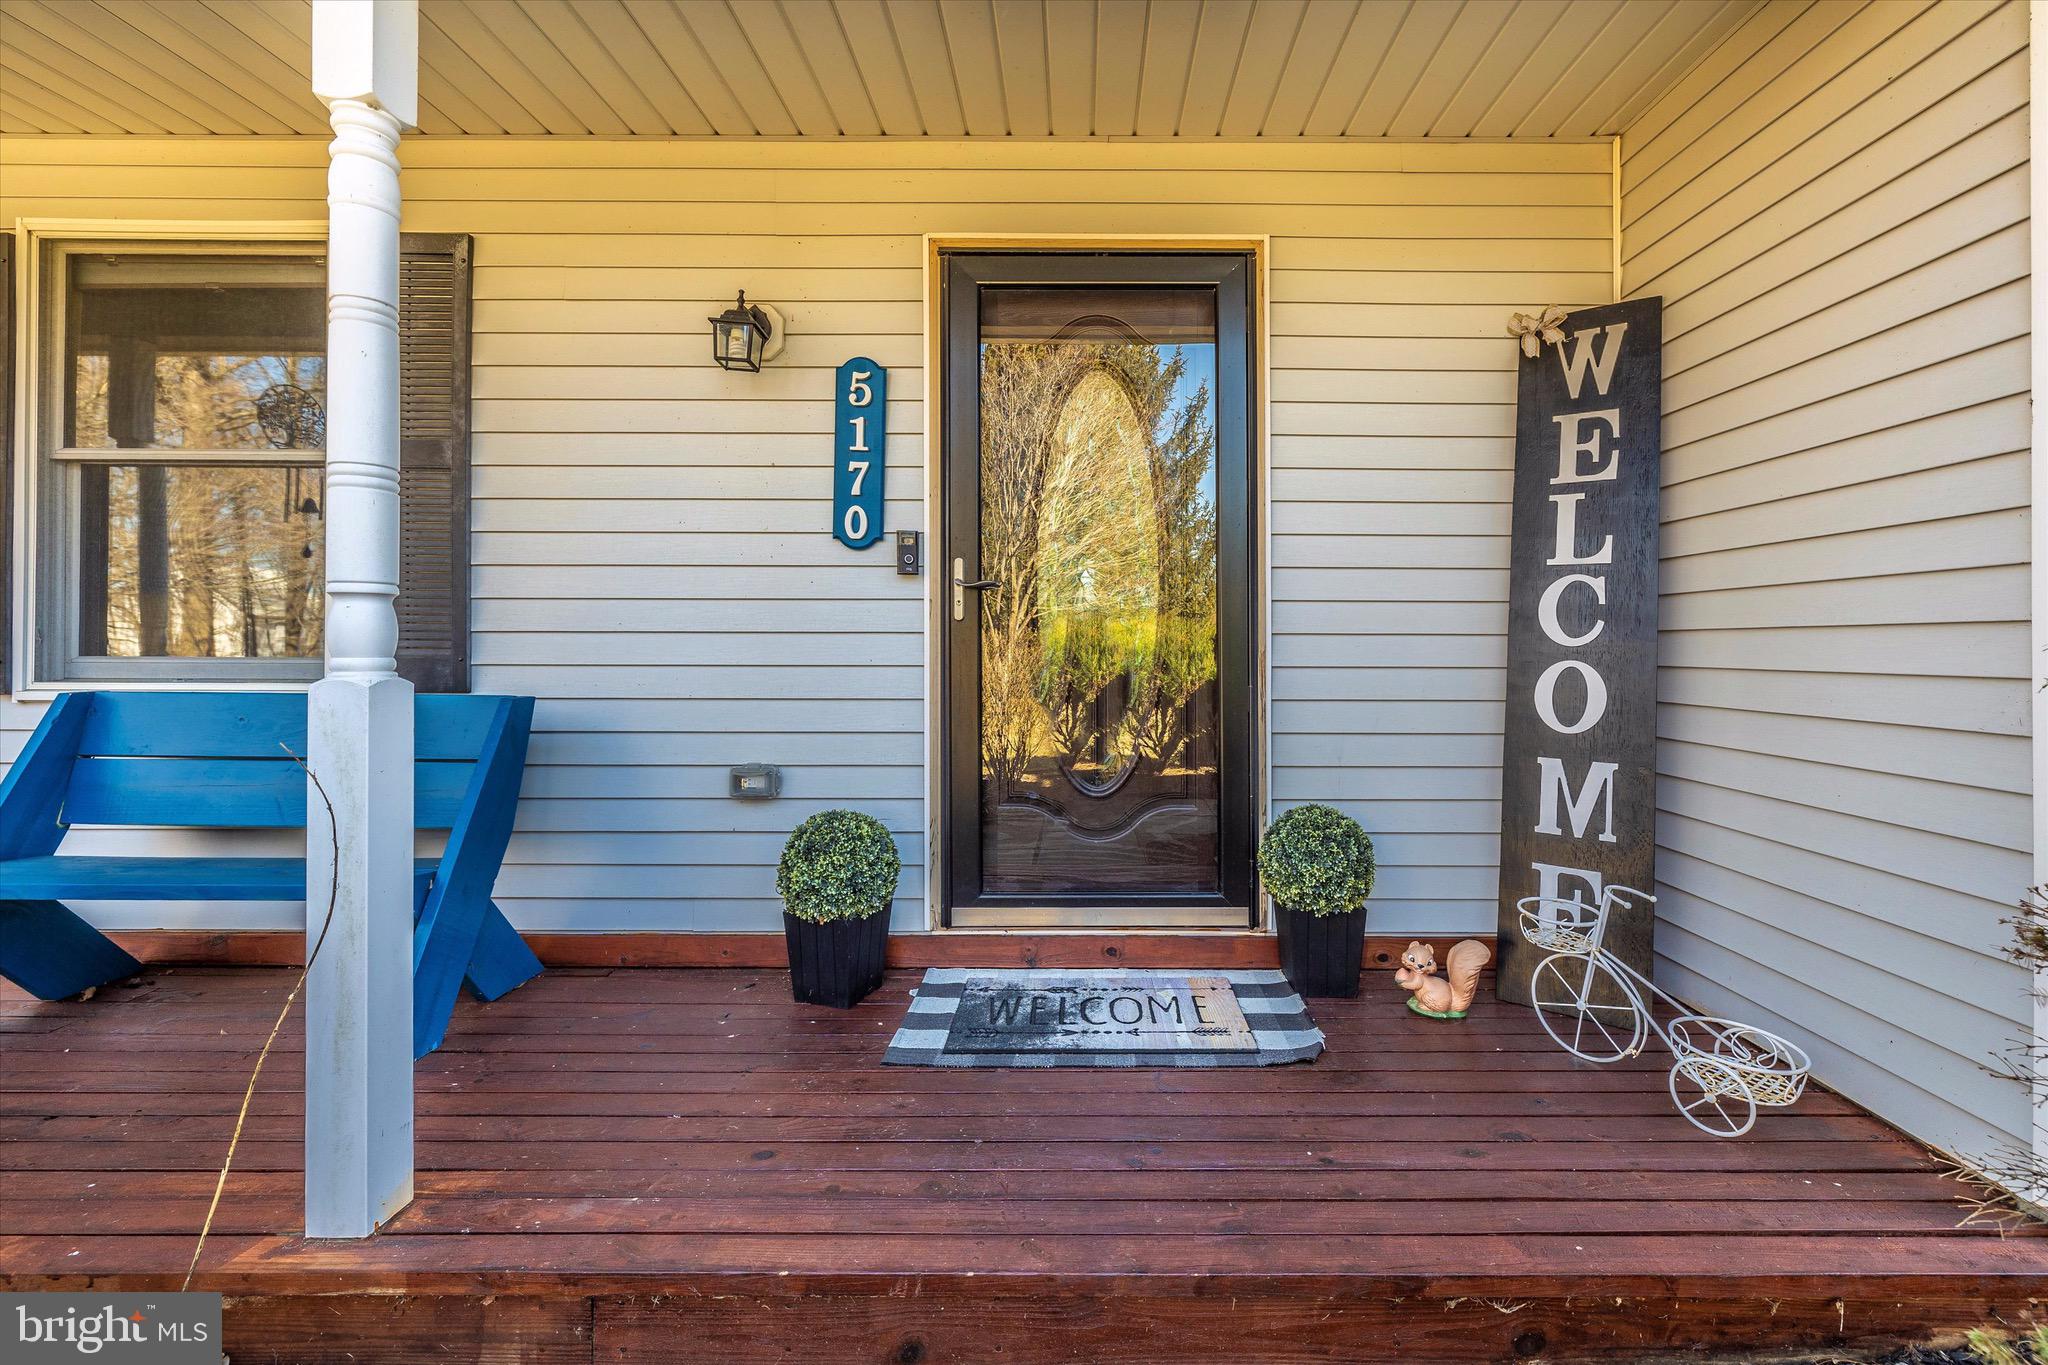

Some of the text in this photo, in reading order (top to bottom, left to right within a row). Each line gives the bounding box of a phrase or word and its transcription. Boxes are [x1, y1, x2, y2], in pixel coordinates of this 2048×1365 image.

[844, 371, 873, 540] 5170
[1531, 322, 1628, 934] WELCOME
[986, 994, 1217, 1026] WELCOME
